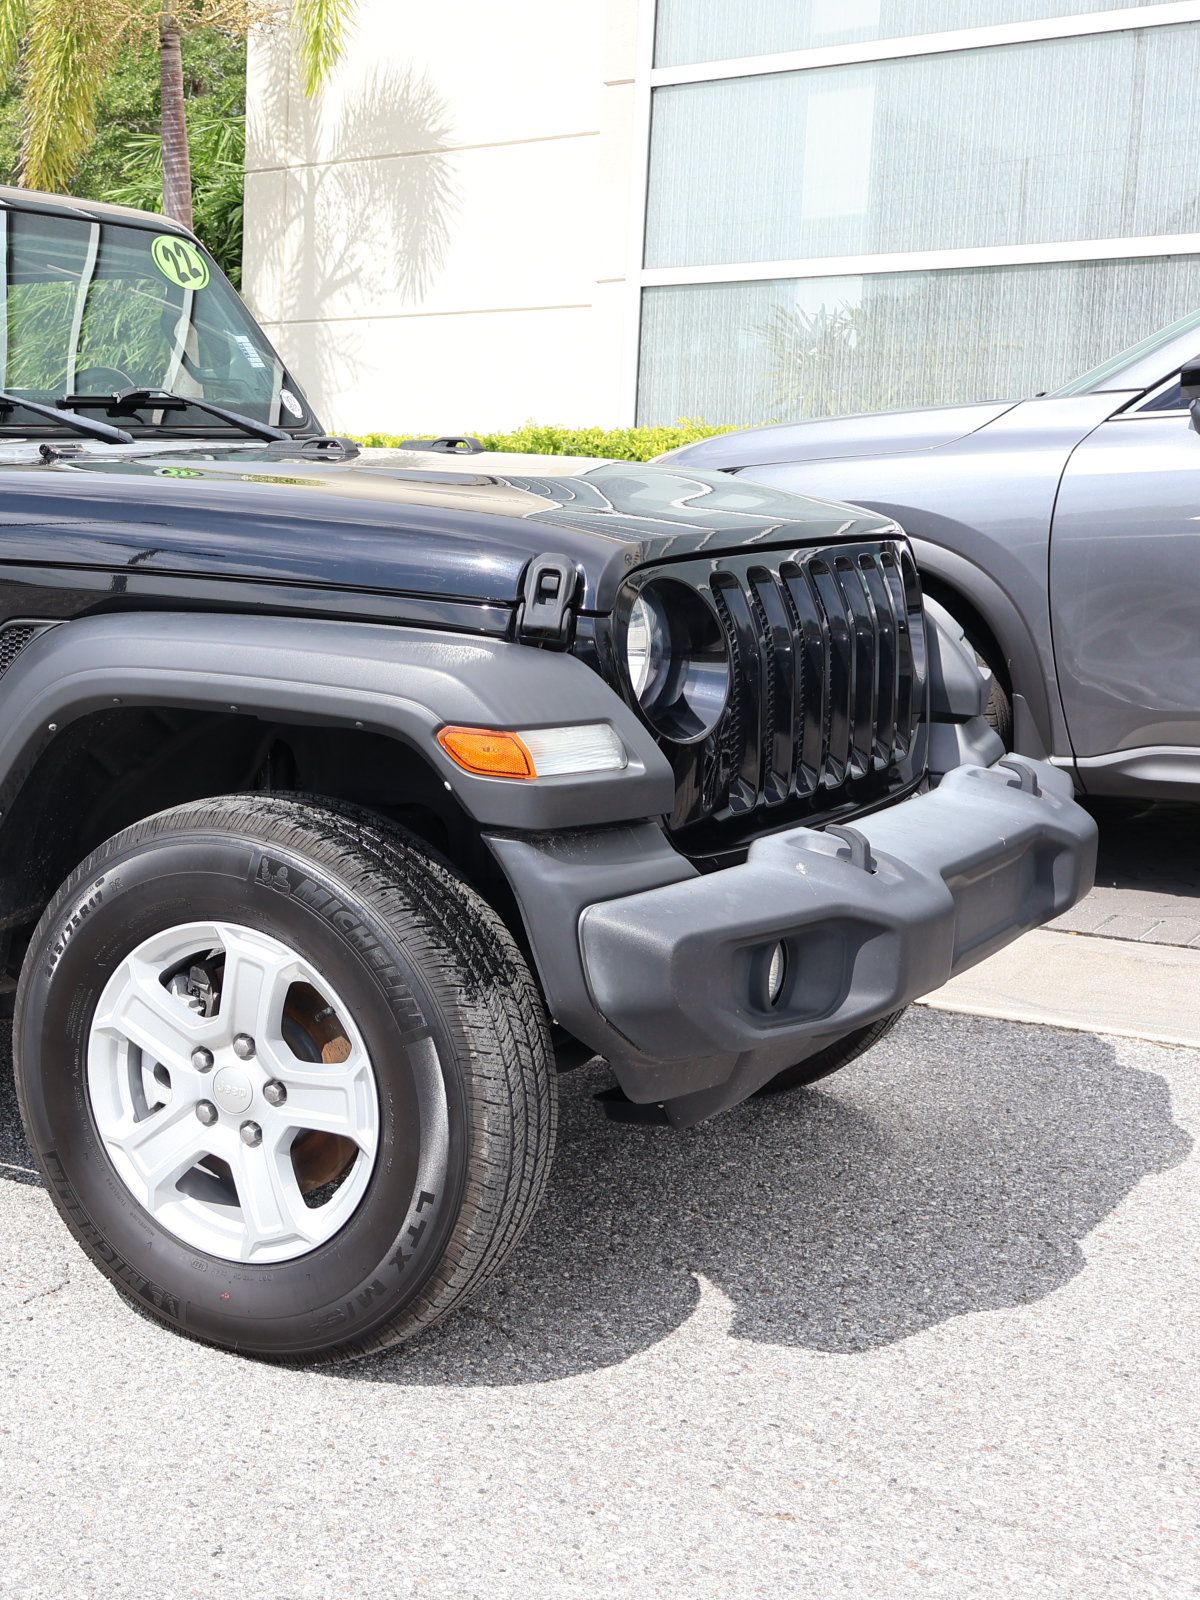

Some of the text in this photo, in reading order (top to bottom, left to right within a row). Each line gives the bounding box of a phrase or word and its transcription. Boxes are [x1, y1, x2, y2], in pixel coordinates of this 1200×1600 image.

[161, 241, 202, 283] 22
[294, 878, 428, 1032] MICHELIN
[388, 1190, 435, 1275] LTX
